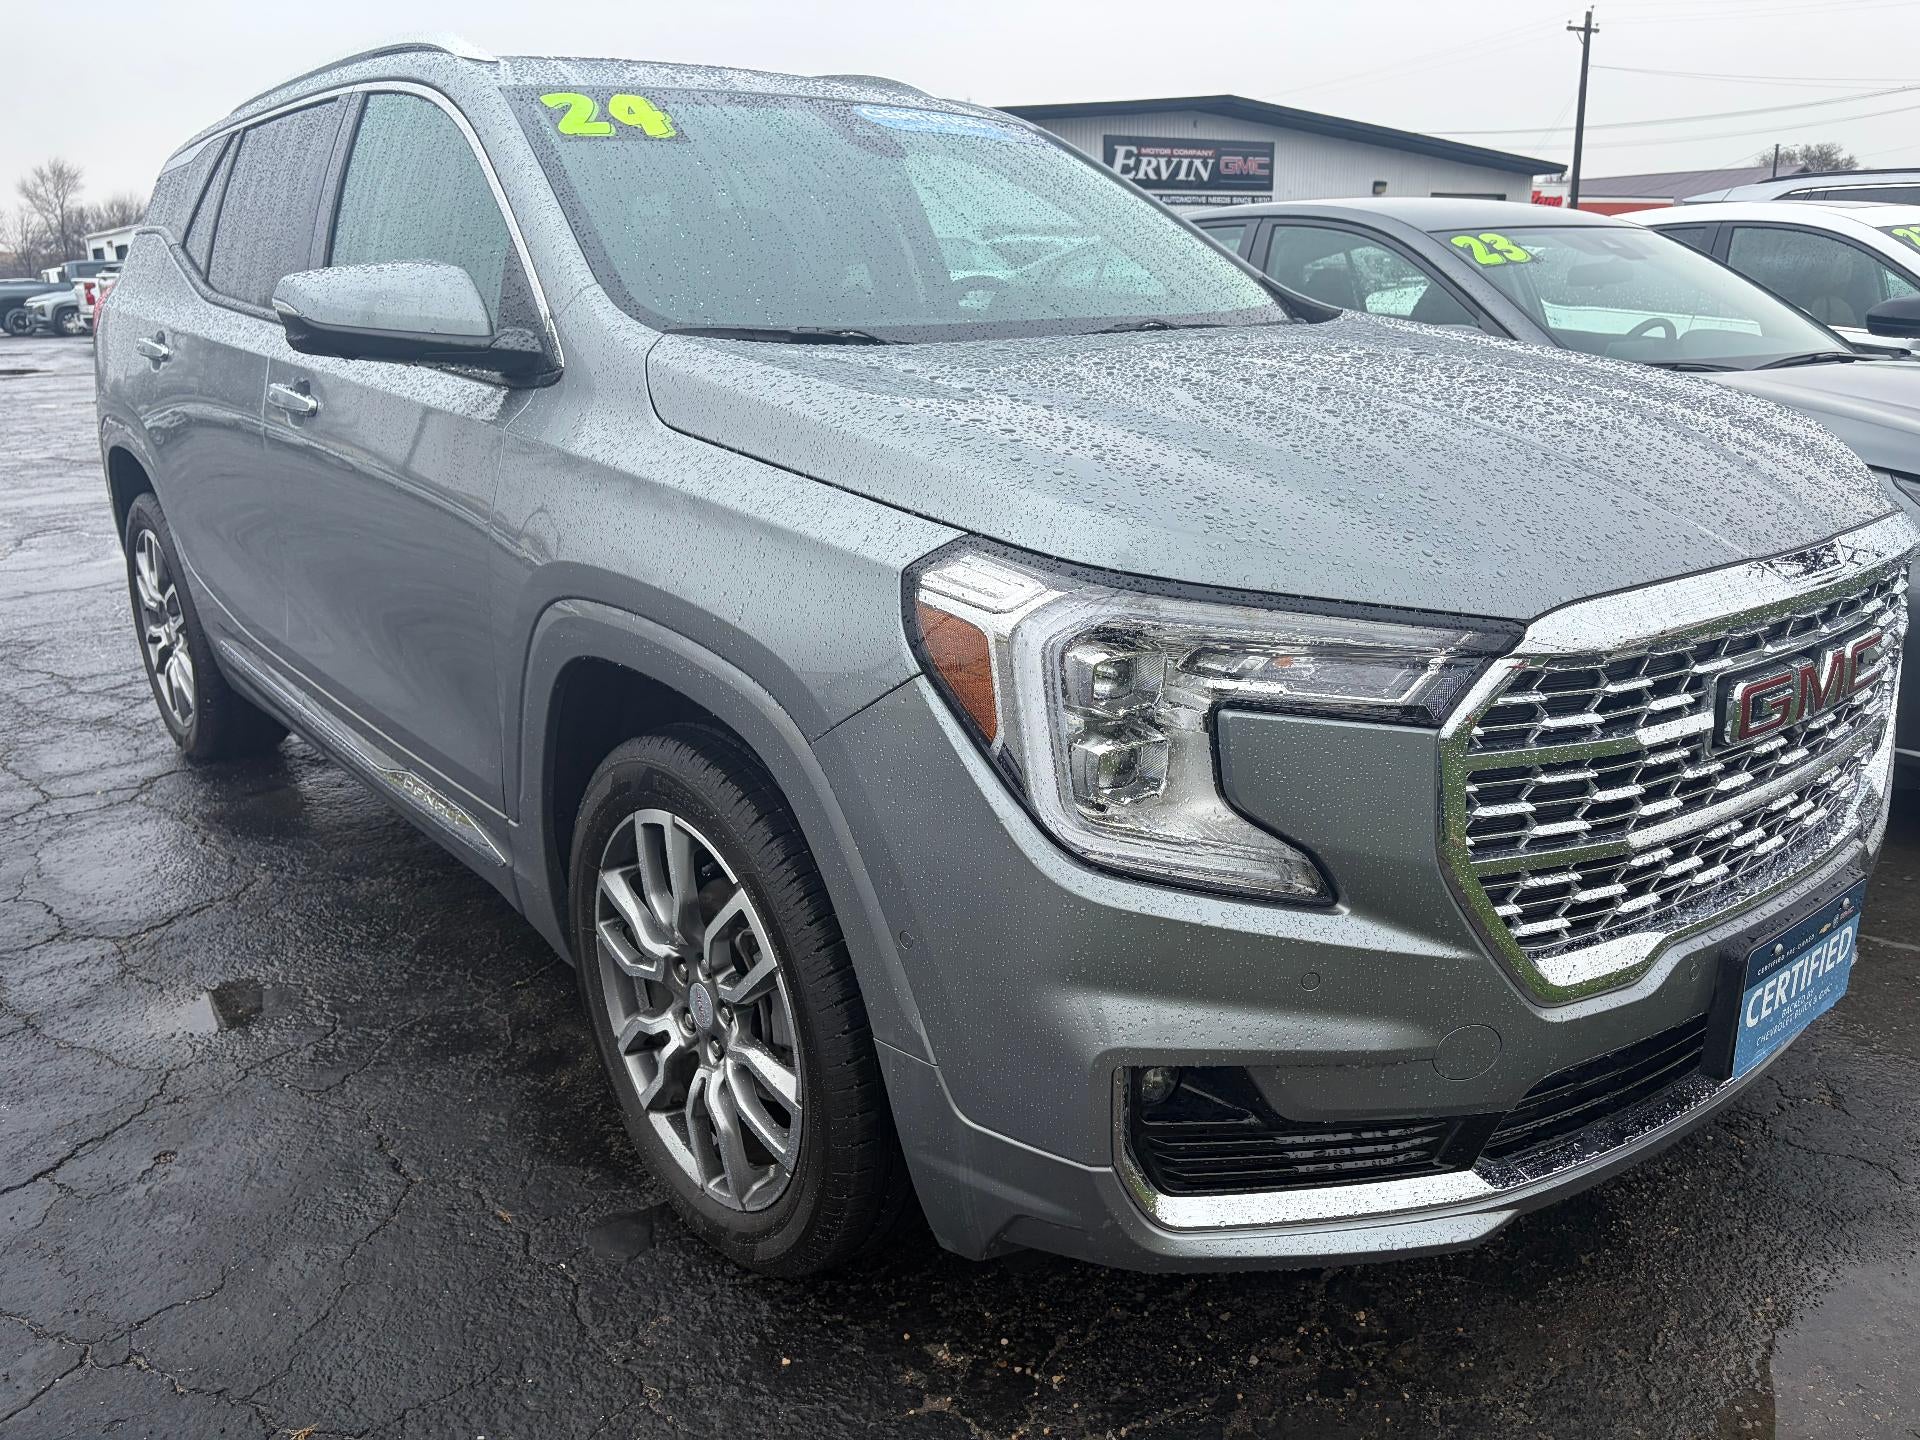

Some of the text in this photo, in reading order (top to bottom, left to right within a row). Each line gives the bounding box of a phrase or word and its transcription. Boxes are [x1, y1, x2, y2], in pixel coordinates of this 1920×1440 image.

[539, 92, 677, 139] 24
[1112, 145, 1215, 182] ERVIN
[1140, 147, 1214, 157] MOTOR COMPANY
[1219, 156, 1270, 175] GMC
[1449, 231, 1534, 266] 23
[1730, 627, 1883, 743] GMC
[1746, 925, 1853, 1028] CERTIFIED
[1757, 955, 1785, 976] CERTIFIED
[1781, 995, 1806, 1018] BACKED
